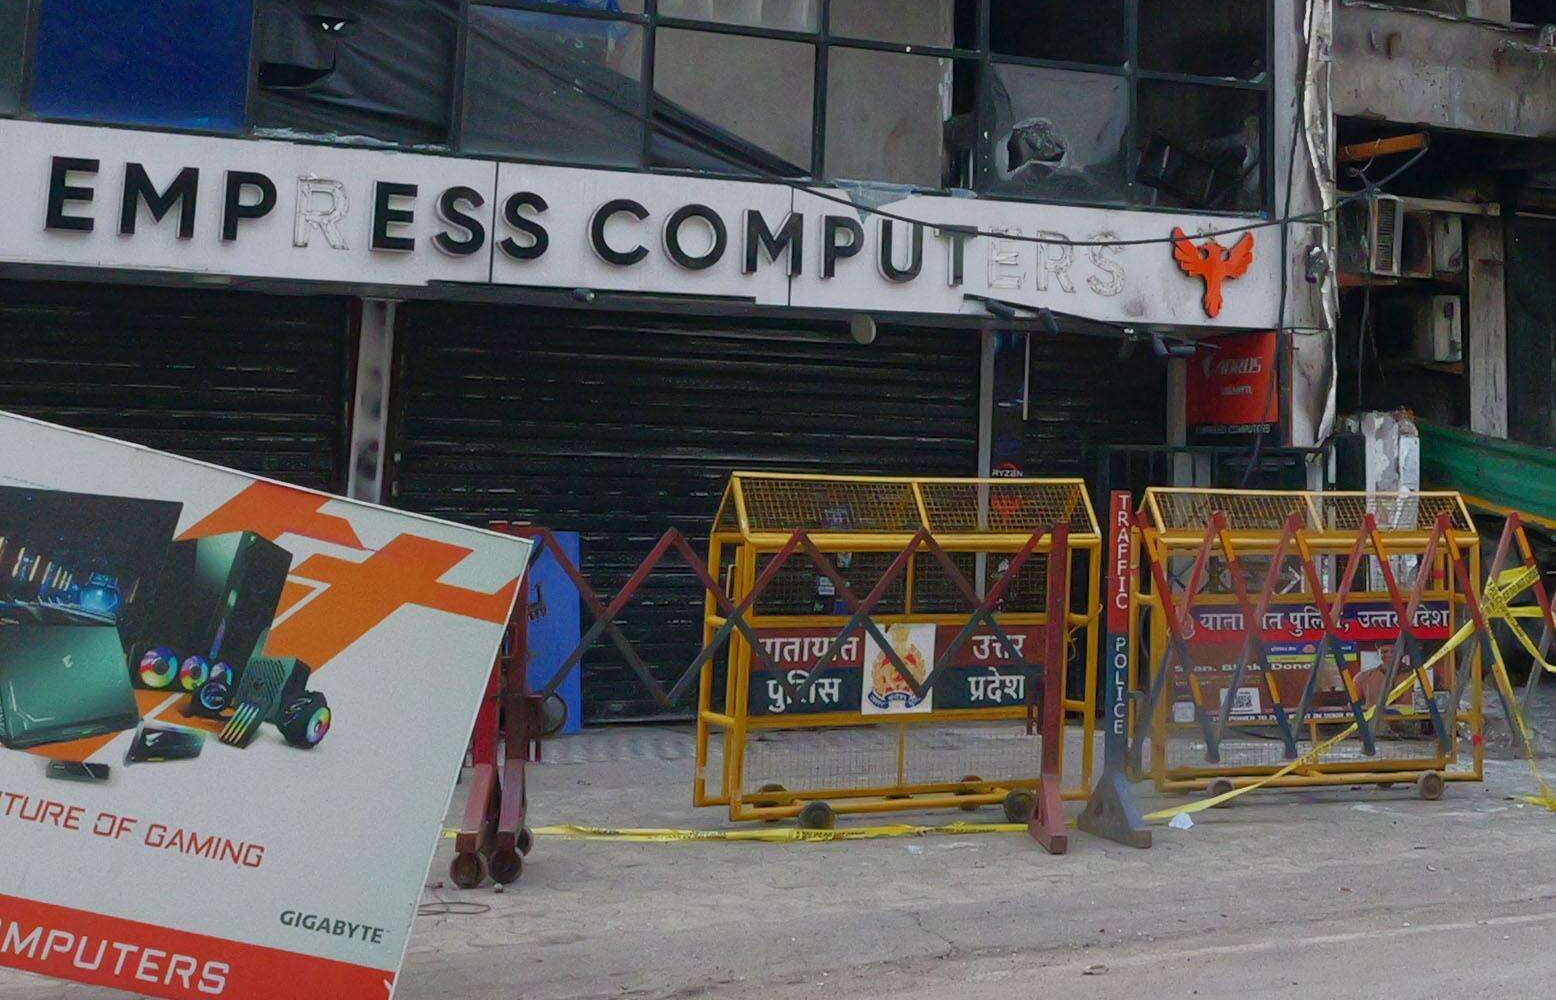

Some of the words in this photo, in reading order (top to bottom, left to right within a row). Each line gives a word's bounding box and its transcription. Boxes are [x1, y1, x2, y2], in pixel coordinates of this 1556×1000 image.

[44, 154, 550, 261] EMPRESS
[588, 198, 1128, 297] COMPUTERS
[1115, 494, 1130, 610] TRAFFIC
[967, 666, 1026, 704] प्रदेश
[1113, 636, 1128, 735] POLICE
[0, 791, 86, 831] TURE
[93, 812, 138, 840] OF
[144, 823, 266, 868] GAMING
[0, 918, 231, 995] MPUTERS
[279, 909, 385, 945] GIGABYTE
